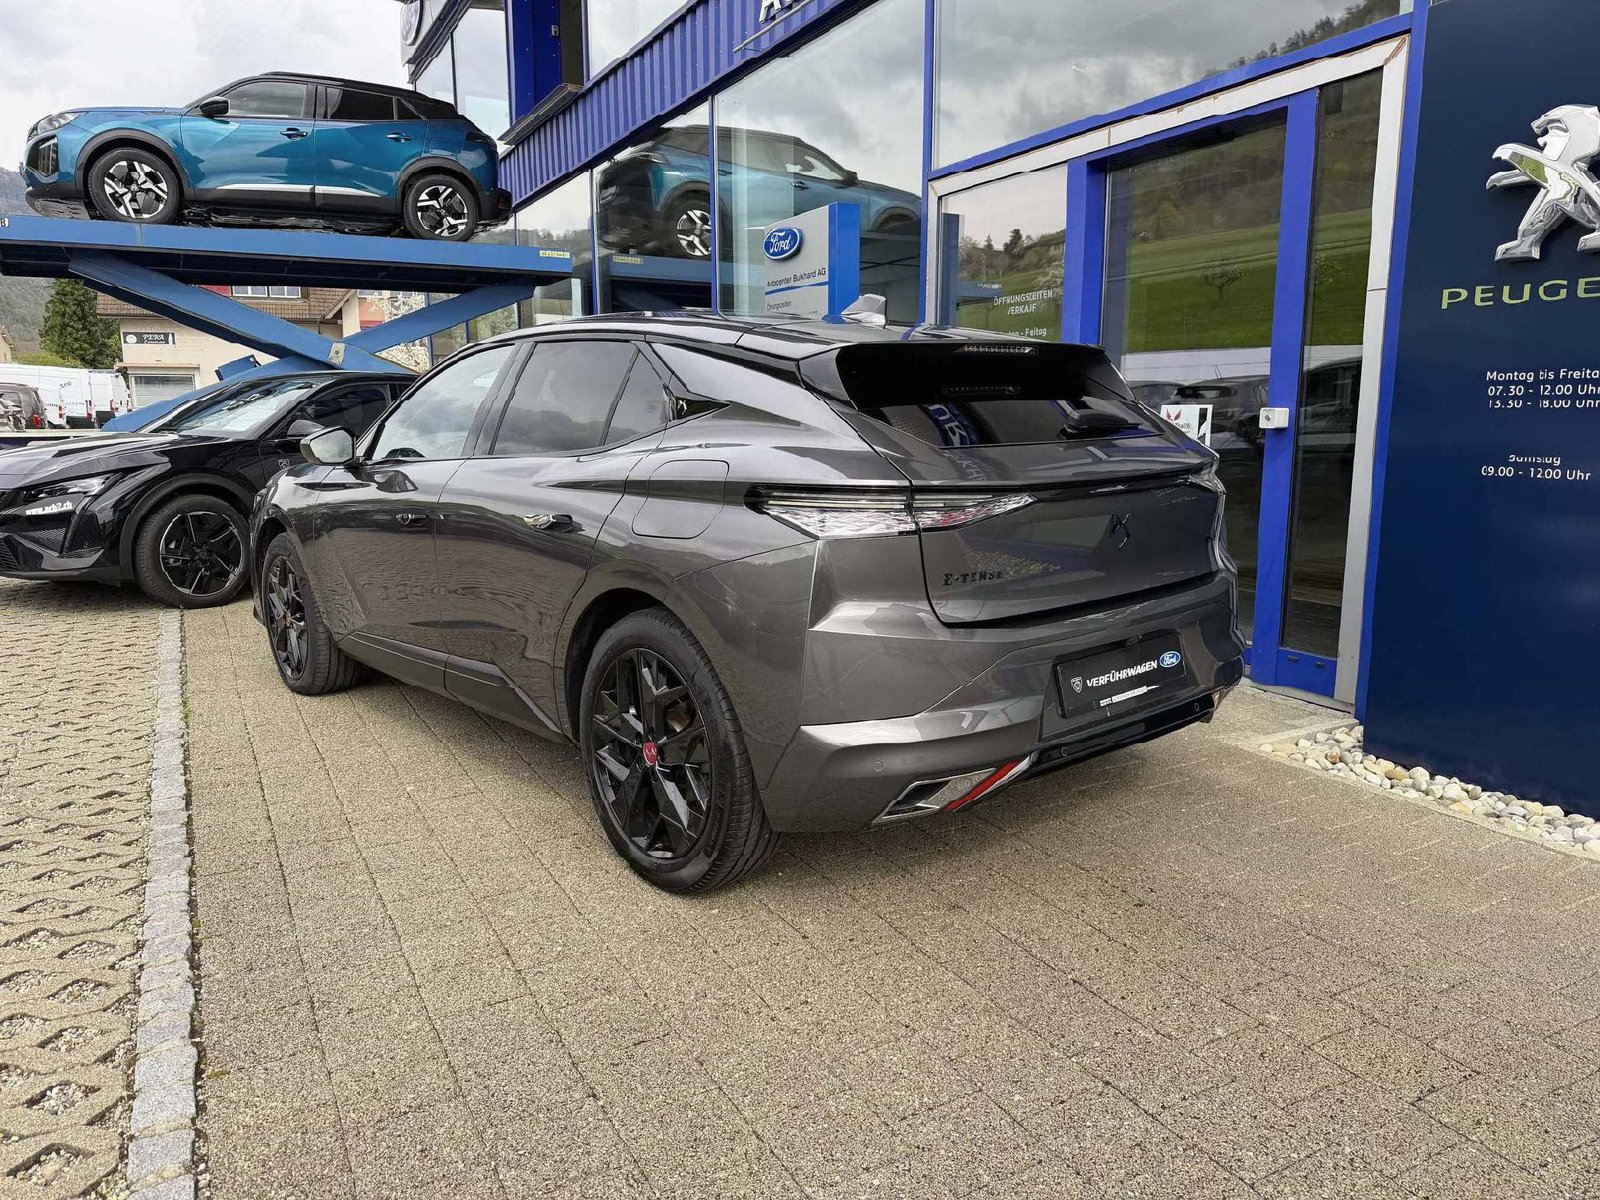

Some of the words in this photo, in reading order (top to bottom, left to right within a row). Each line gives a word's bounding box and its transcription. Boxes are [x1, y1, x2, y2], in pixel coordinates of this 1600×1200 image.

[817, 267, 826, 277] AG
[1486, 371, 1534, 383] Montag
[1539, 369, 1555, 380] bis
[1488, 386, 1524, 396] 07.30
[1540, 385, 1573, 395] 12.00
[1481, 466, 1514, 477] 09.00
[1566, 469, 1591, 481] Uhr
